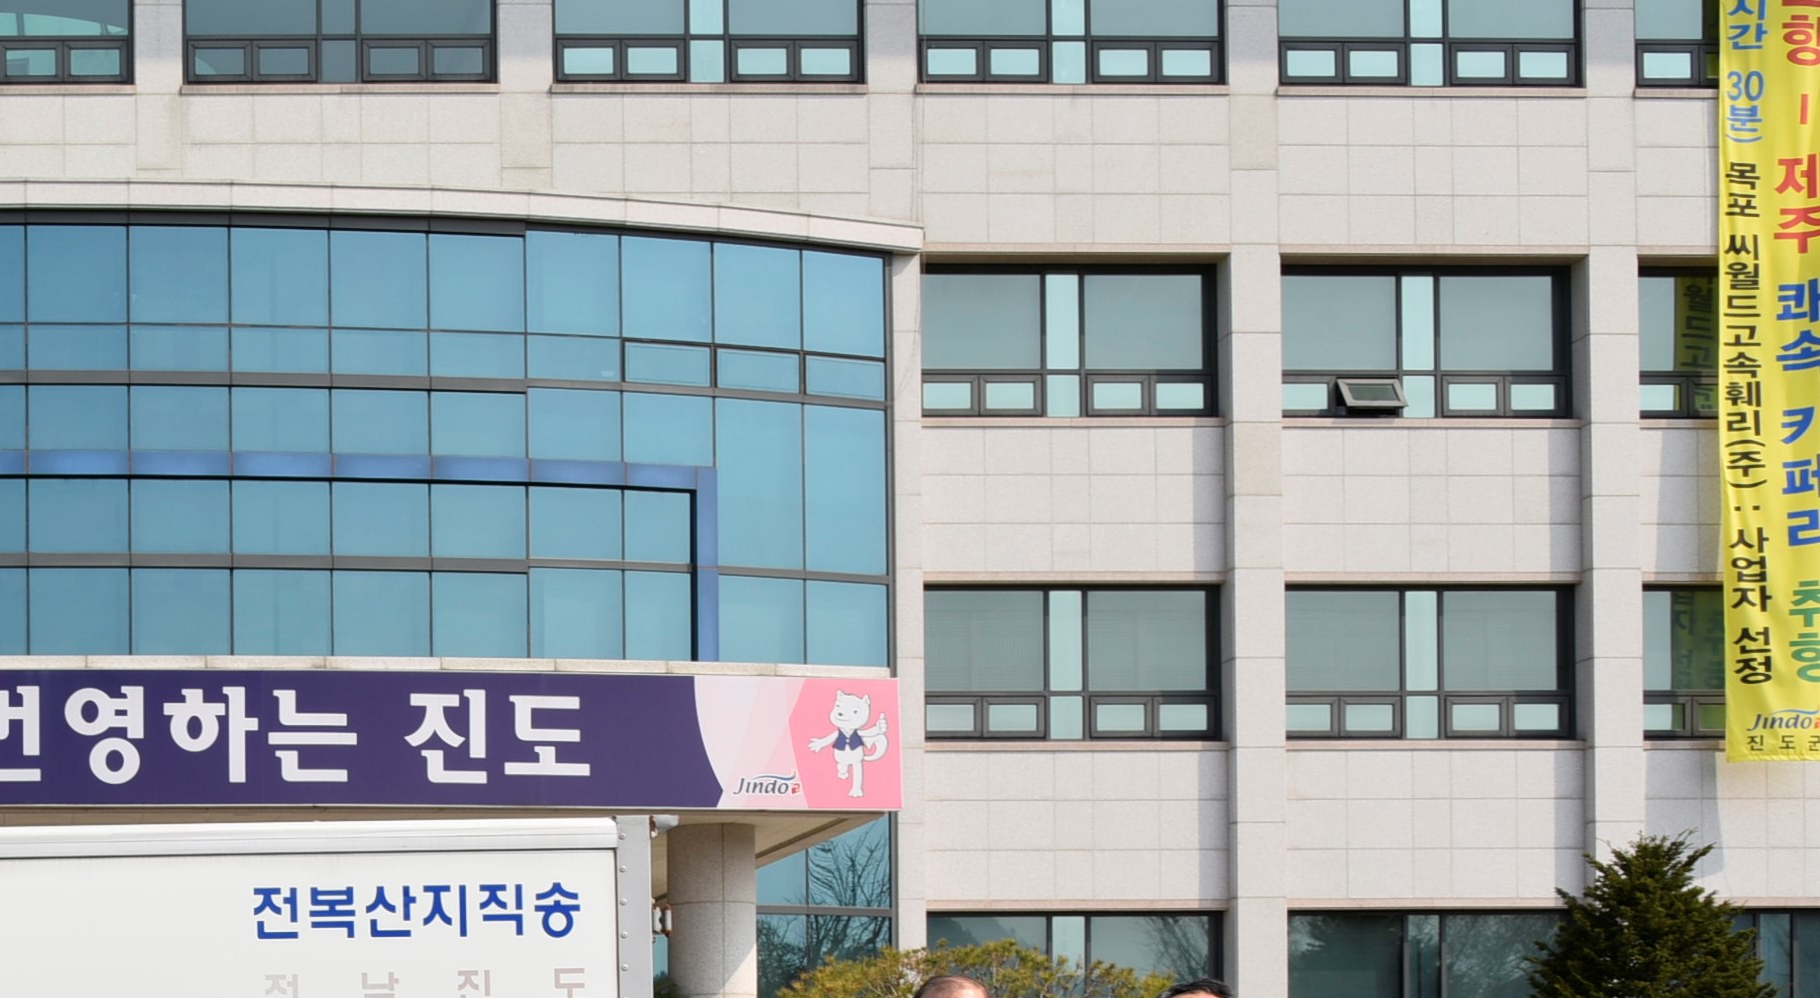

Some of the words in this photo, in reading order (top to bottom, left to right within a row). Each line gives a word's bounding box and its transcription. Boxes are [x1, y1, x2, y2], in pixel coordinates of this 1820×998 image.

[1782, 0, 1820, 66] 항
[1724, 161, 1760, 218] 목포
[1729, 526, 1773, 613] 사업자
[1732, 626, 1773, 685] 선정
[404, 691, 592, 785] 진도
[1746, 713, 1813, 732] Jindo
[733, 777, 789, 795] Jindo
[253, 882, 581, 940] 전복산지직송
